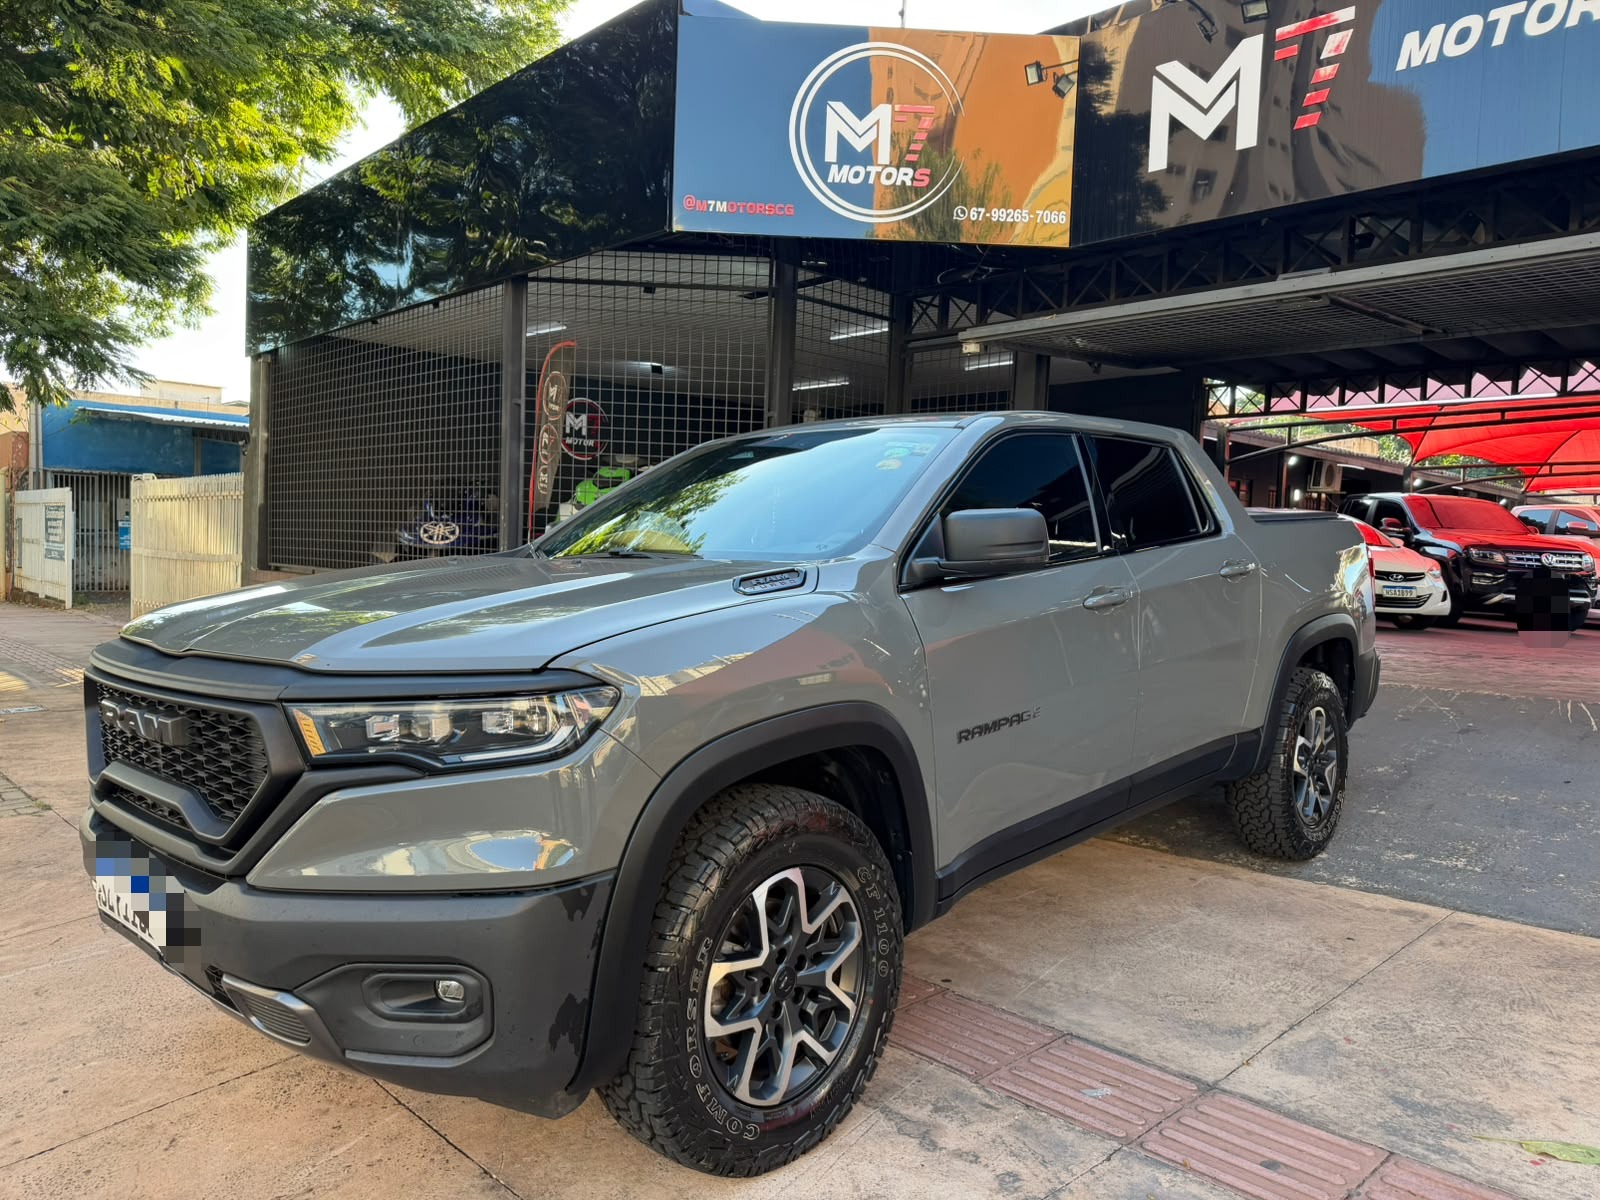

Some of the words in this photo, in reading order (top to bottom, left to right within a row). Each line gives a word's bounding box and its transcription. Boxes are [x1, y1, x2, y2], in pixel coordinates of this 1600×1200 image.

[1148, 5, 1356, 173] M7
[824, 100, 936, 166] M7
[827, 164, 932, 188] MOTORS
[683, 194, 795, 217] @M7MOTORSCG
[969, 206, 1067, 224] 67-99265-7066
[101, 699, 174, 746] RAM
[957, 706, 1041, 744] RAMPAGE
[857, 866, 881, 900] CF
[874, 907, 889, 978] 1100
